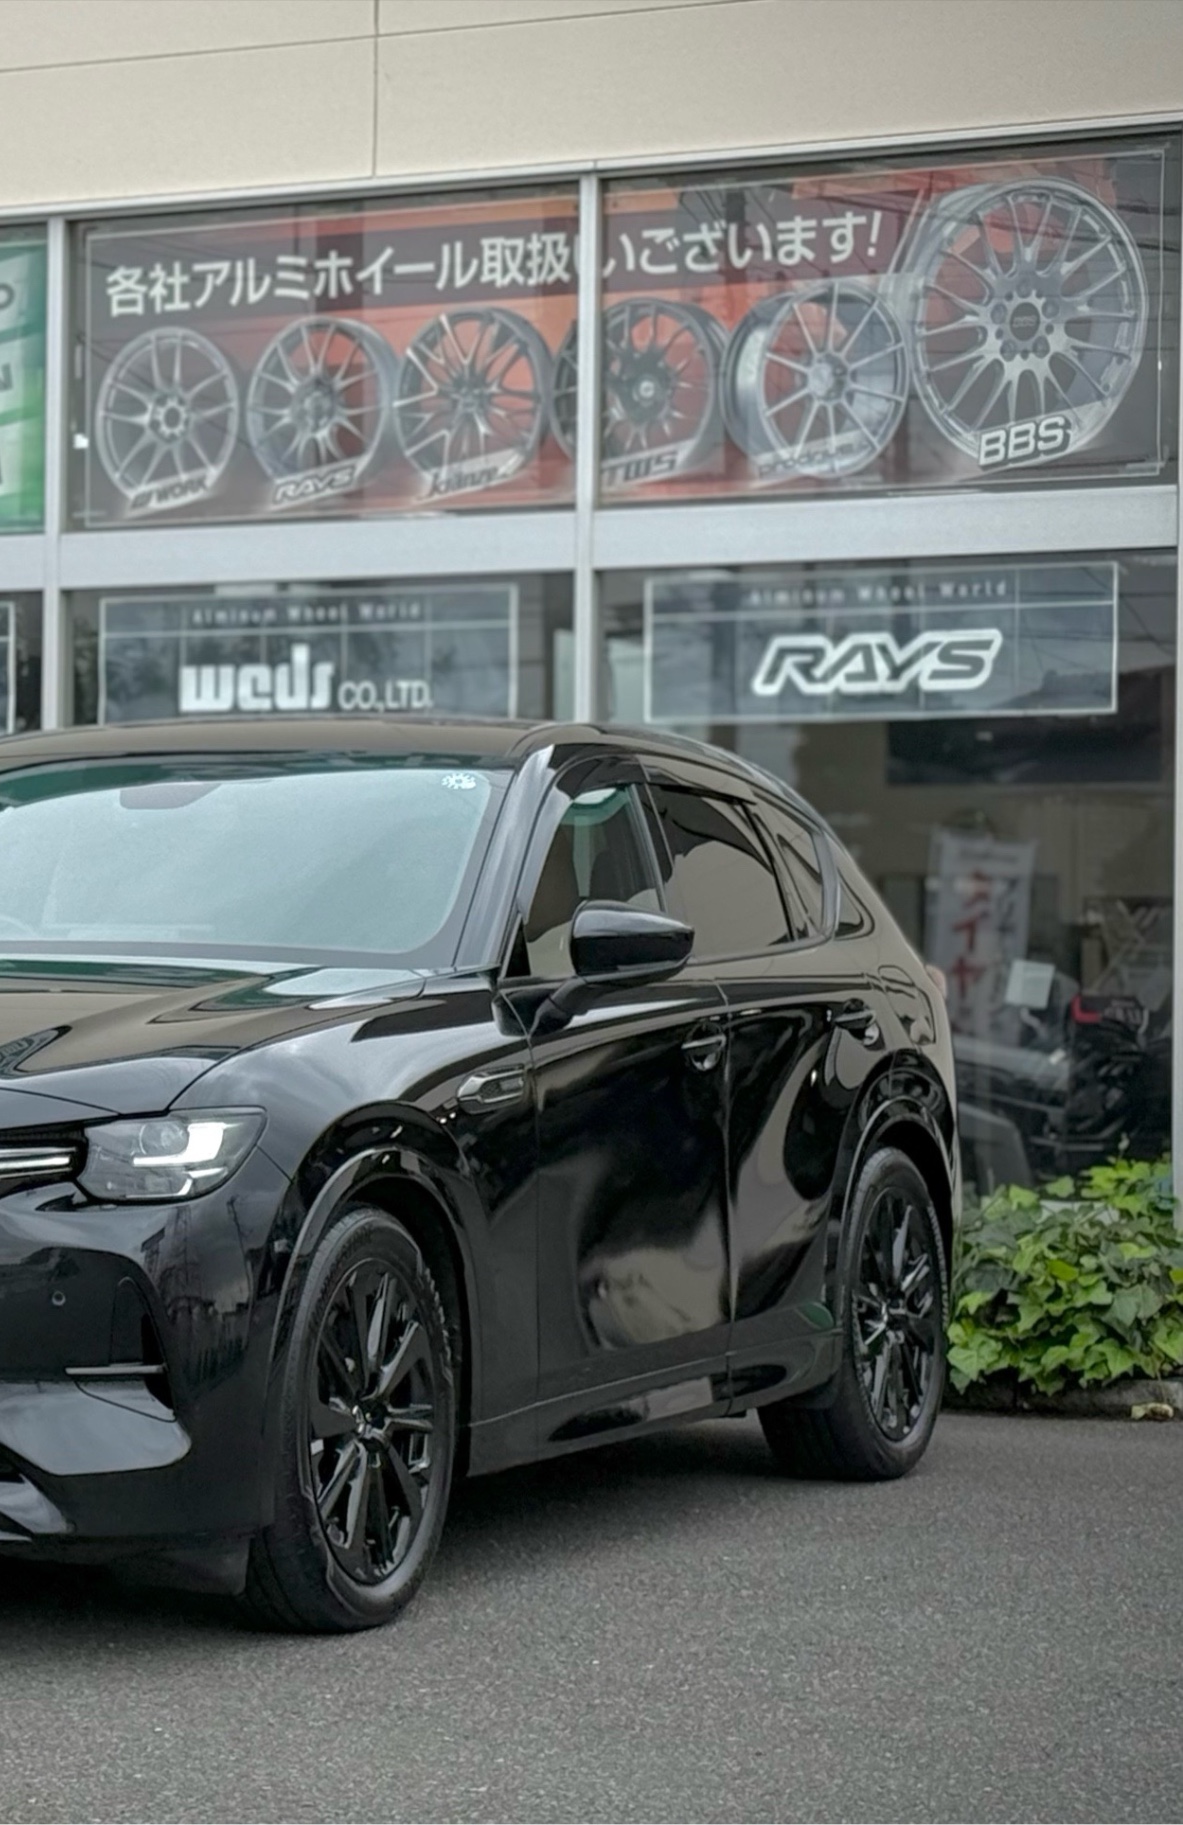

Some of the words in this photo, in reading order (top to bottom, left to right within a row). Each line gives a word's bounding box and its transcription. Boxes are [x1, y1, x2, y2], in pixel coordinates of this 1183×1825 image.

[978, 405, 1068, 467] BBS
[273, 465, 356, 504] RAYS
[179, 642, 335, 713] weds
[753, 628, 1003, 695] RAYS
